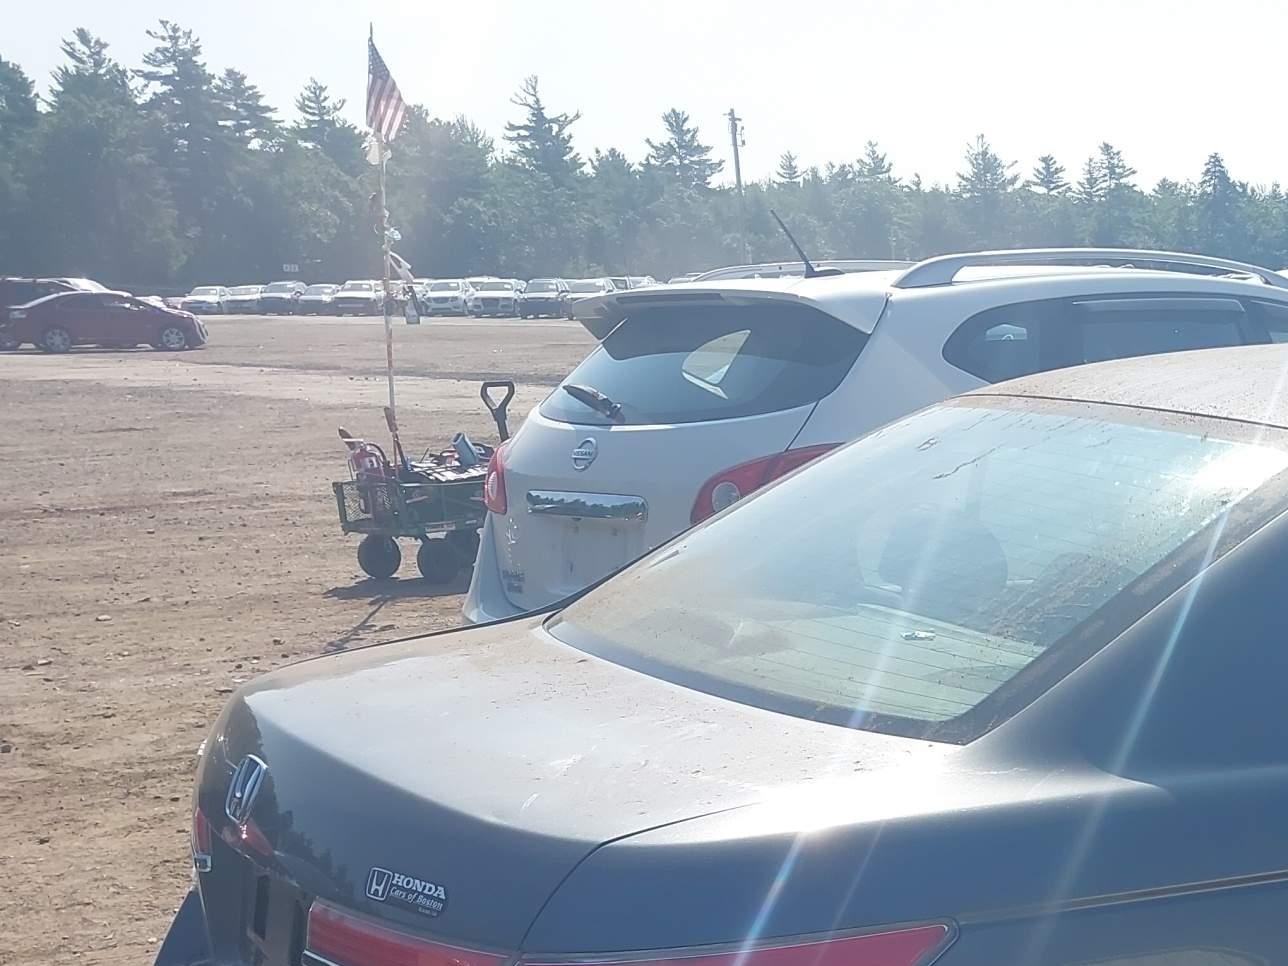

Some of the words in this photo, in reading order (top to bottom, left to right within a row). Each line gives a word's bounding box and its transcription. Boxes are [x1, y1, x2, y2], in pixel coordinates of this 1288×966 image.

[390, 886, 407, 899] Cars
[407, 892, 418, 904] of
[416, 894, 444, 912] Boston
[392, 873, 446, 899] HONDA
